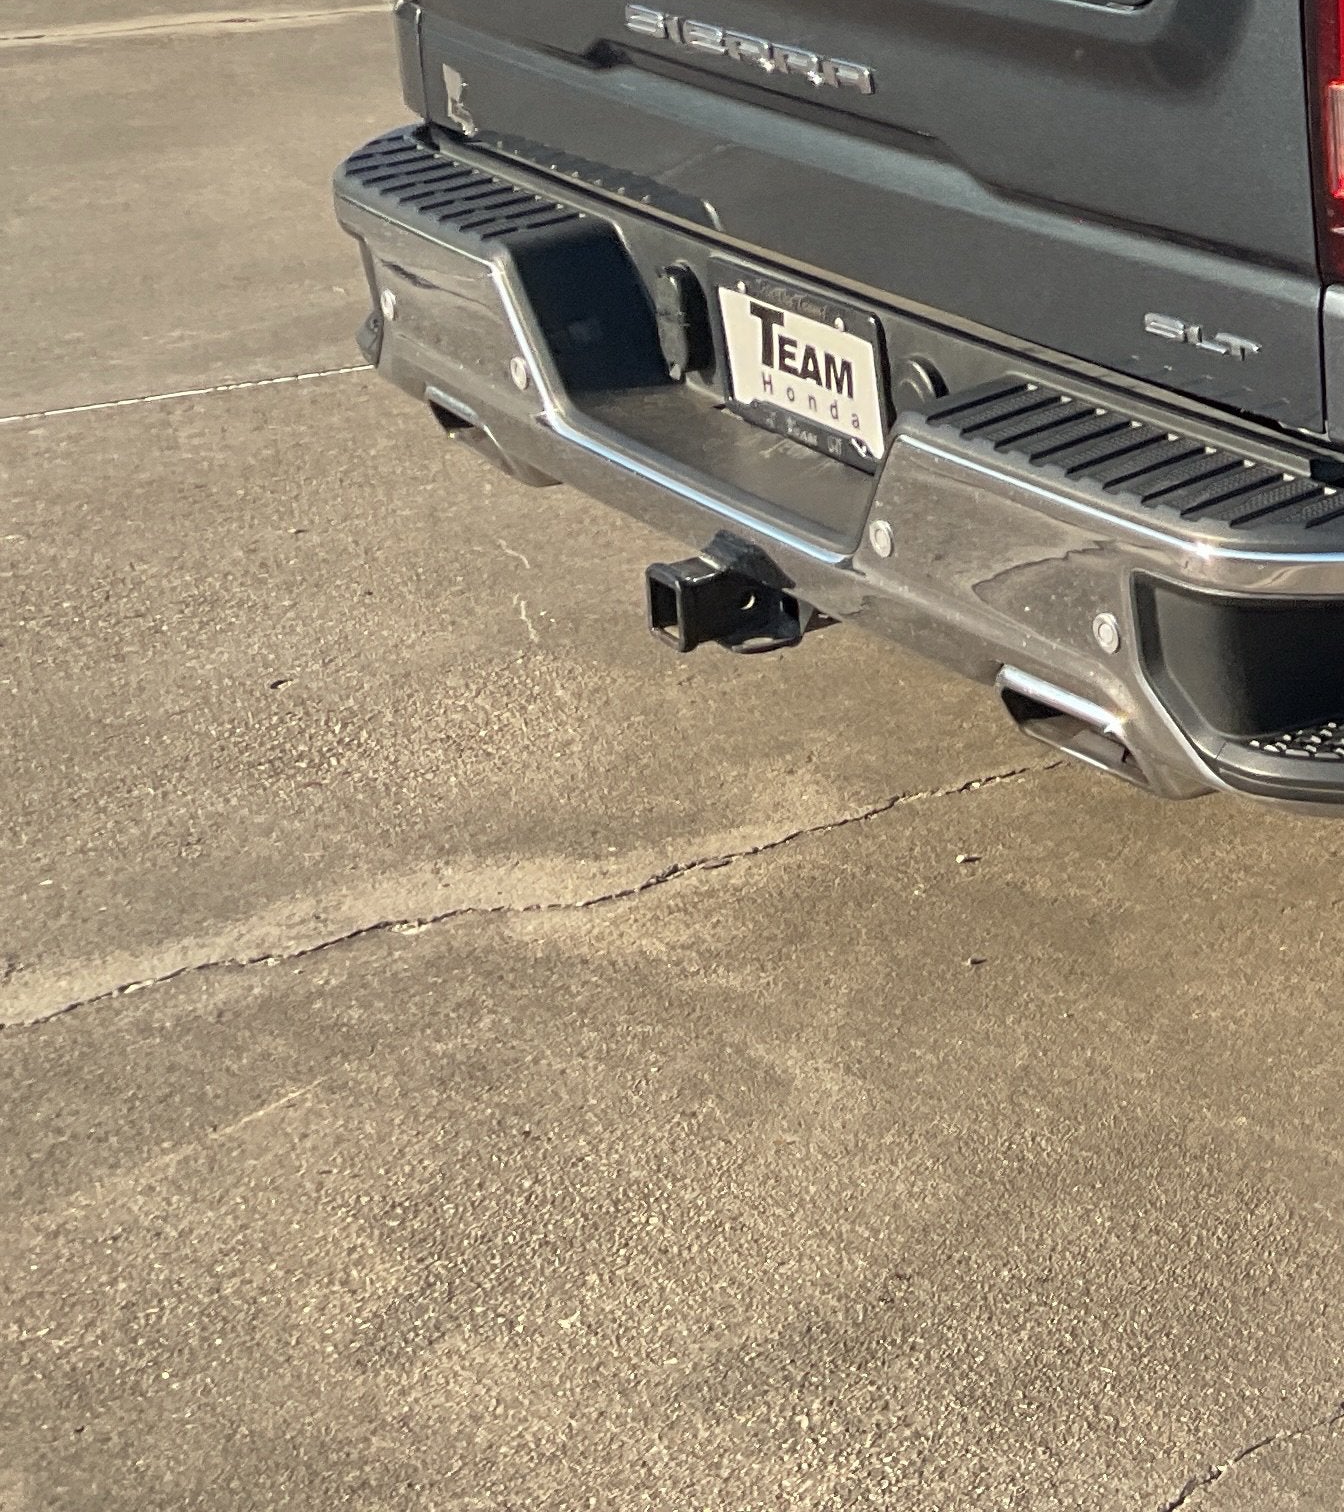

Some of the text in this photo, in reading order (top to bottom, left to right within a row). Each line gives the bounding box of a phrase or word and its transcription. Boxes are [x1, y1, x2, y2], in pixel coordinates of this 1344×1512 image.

[625, 4, 876, 95] SIERRA
[750, 301, 854, 399] TEAM
[1144, 313, 1261, 360] SLT
[762, 371, 861, 431] Honda
